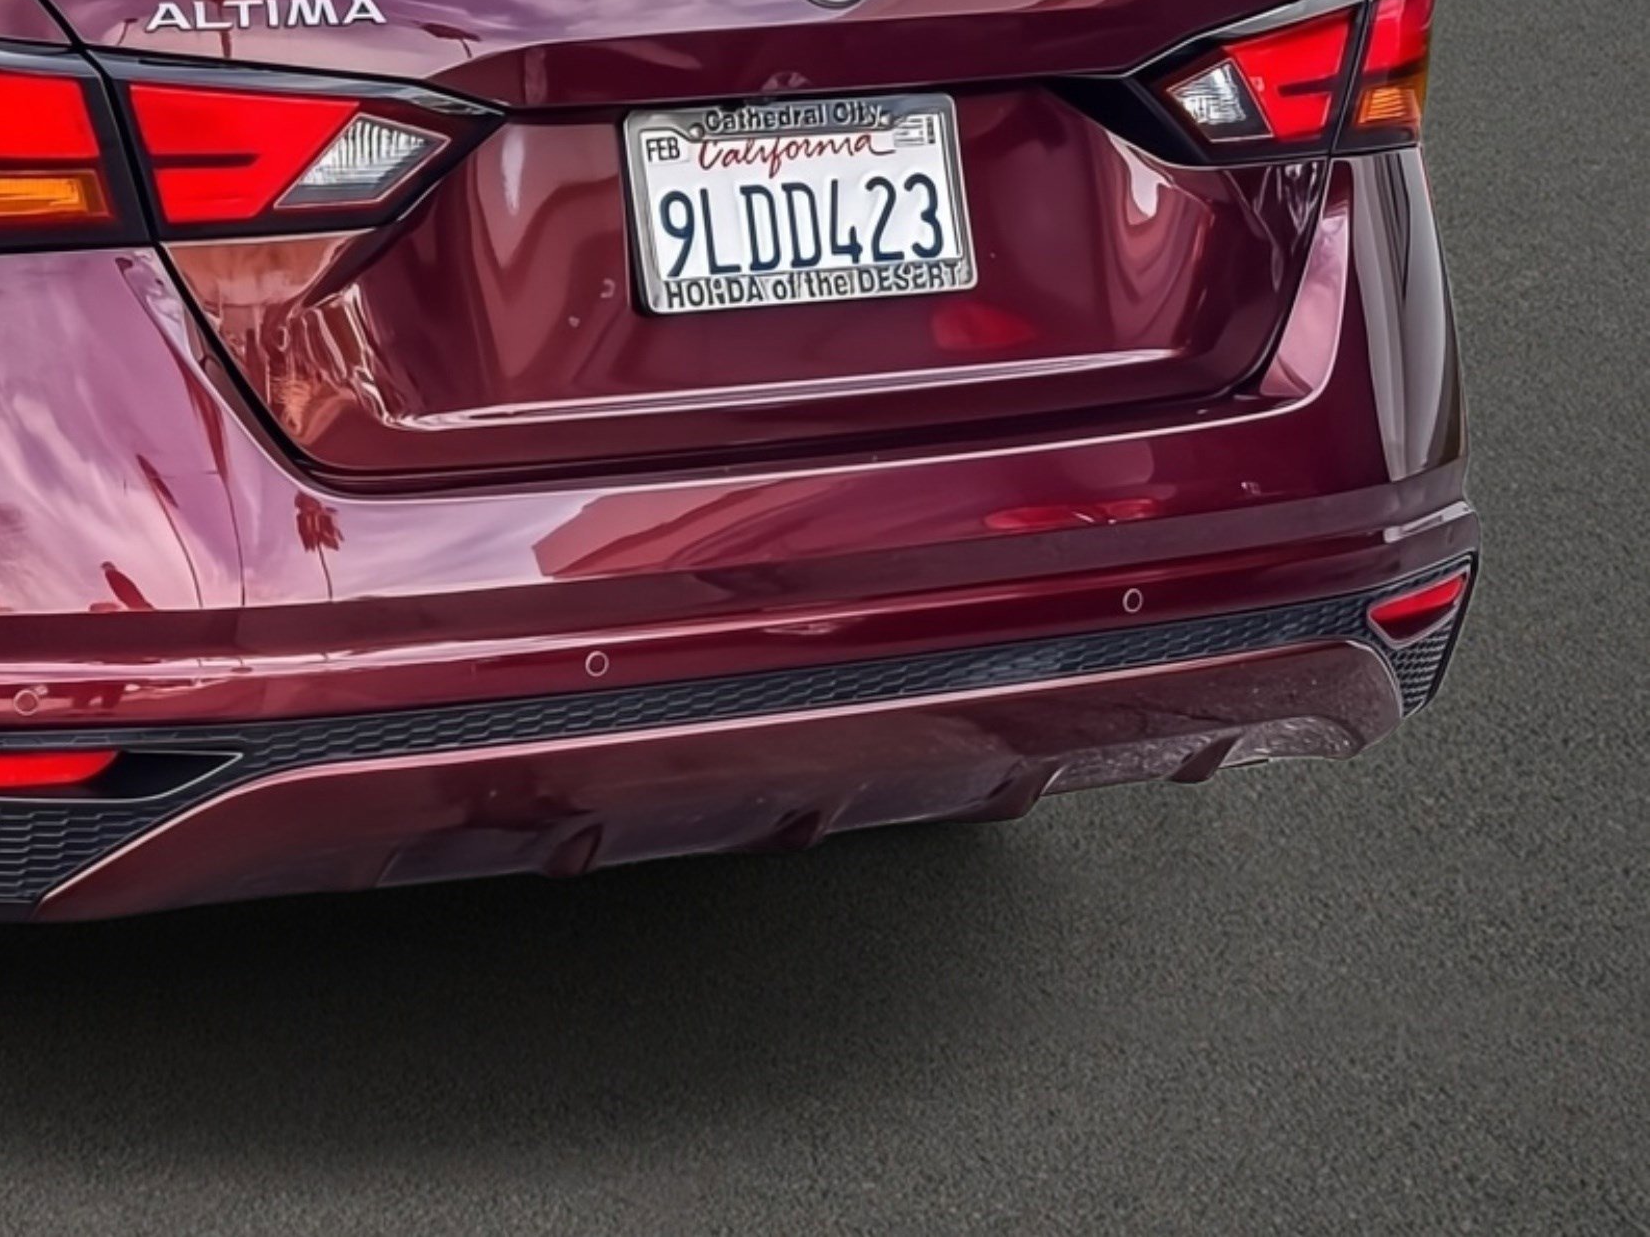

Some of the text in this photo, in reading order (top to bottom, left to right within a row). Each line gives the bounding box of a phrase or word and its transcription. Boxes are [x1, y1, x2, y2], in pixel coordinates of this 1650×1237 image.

[704, 100, 883, 132] Cathedral City
[646, 136, 681, 162] FEB
[697, 132, 896, 179] California
[658, 172, 945, 278] 9LDD423
[664, 261, 962, 309] HONDA of the DESERT
